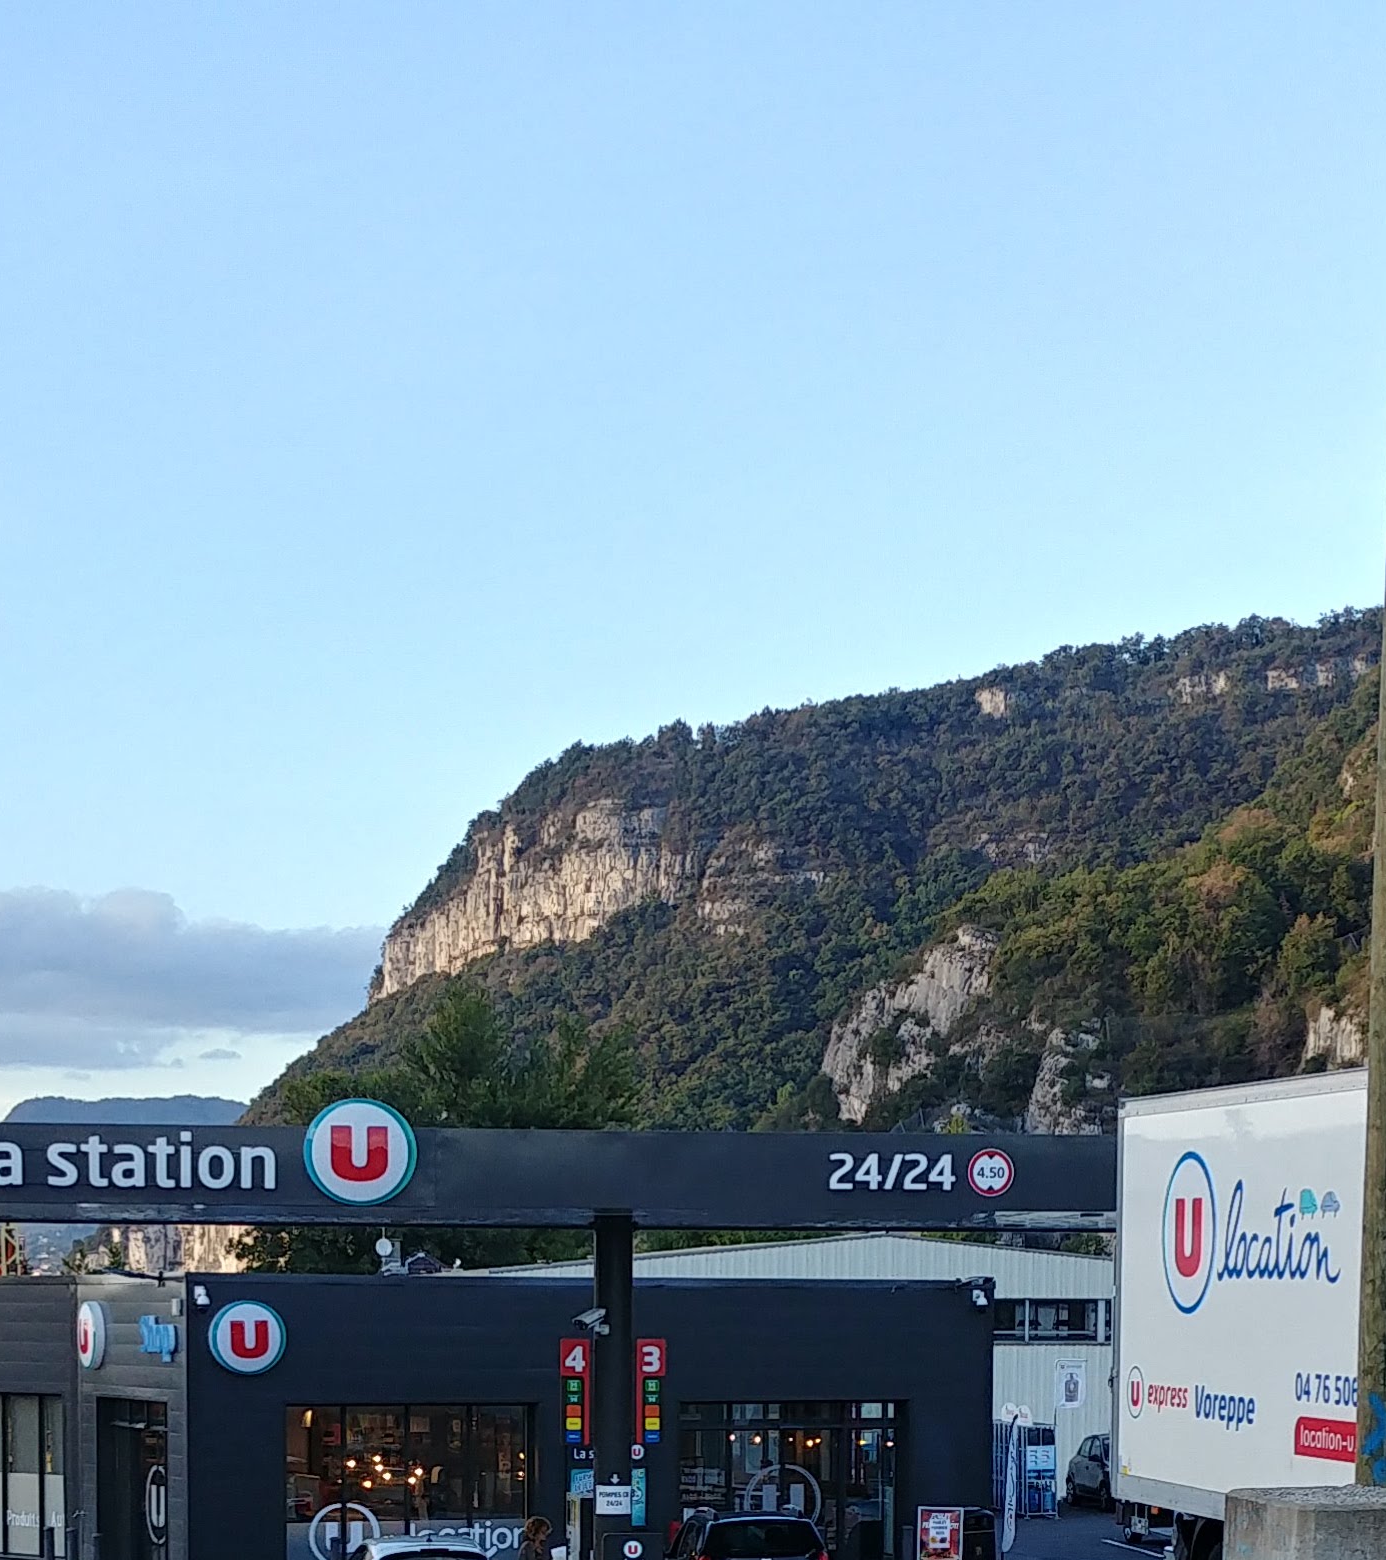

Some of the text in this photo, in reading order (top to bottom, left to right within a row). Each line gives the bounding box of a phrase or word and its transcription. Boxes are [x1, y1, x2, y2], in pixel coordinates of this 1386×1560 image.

[47, 1131, 276, 1189] station
[331, 1126, 388, 1181] U
[829, 1153, 956, 1191] 24/24
[977, 1167, 1005, 1180] 4.50
[1175, 1179, 1341, 1284] U location
[230, 1320, 269, 1358] U
[564, 1345, 586, 1372] 4
[641, 1345, 661, 1373] 3
[1296, 1372, 1311, 1402] 04
[1315, 1374, 1330, 1404] 76
[1130, 1380, 1256, 1432] U express Voreppe
[573, 1448, 586, 1459] La
